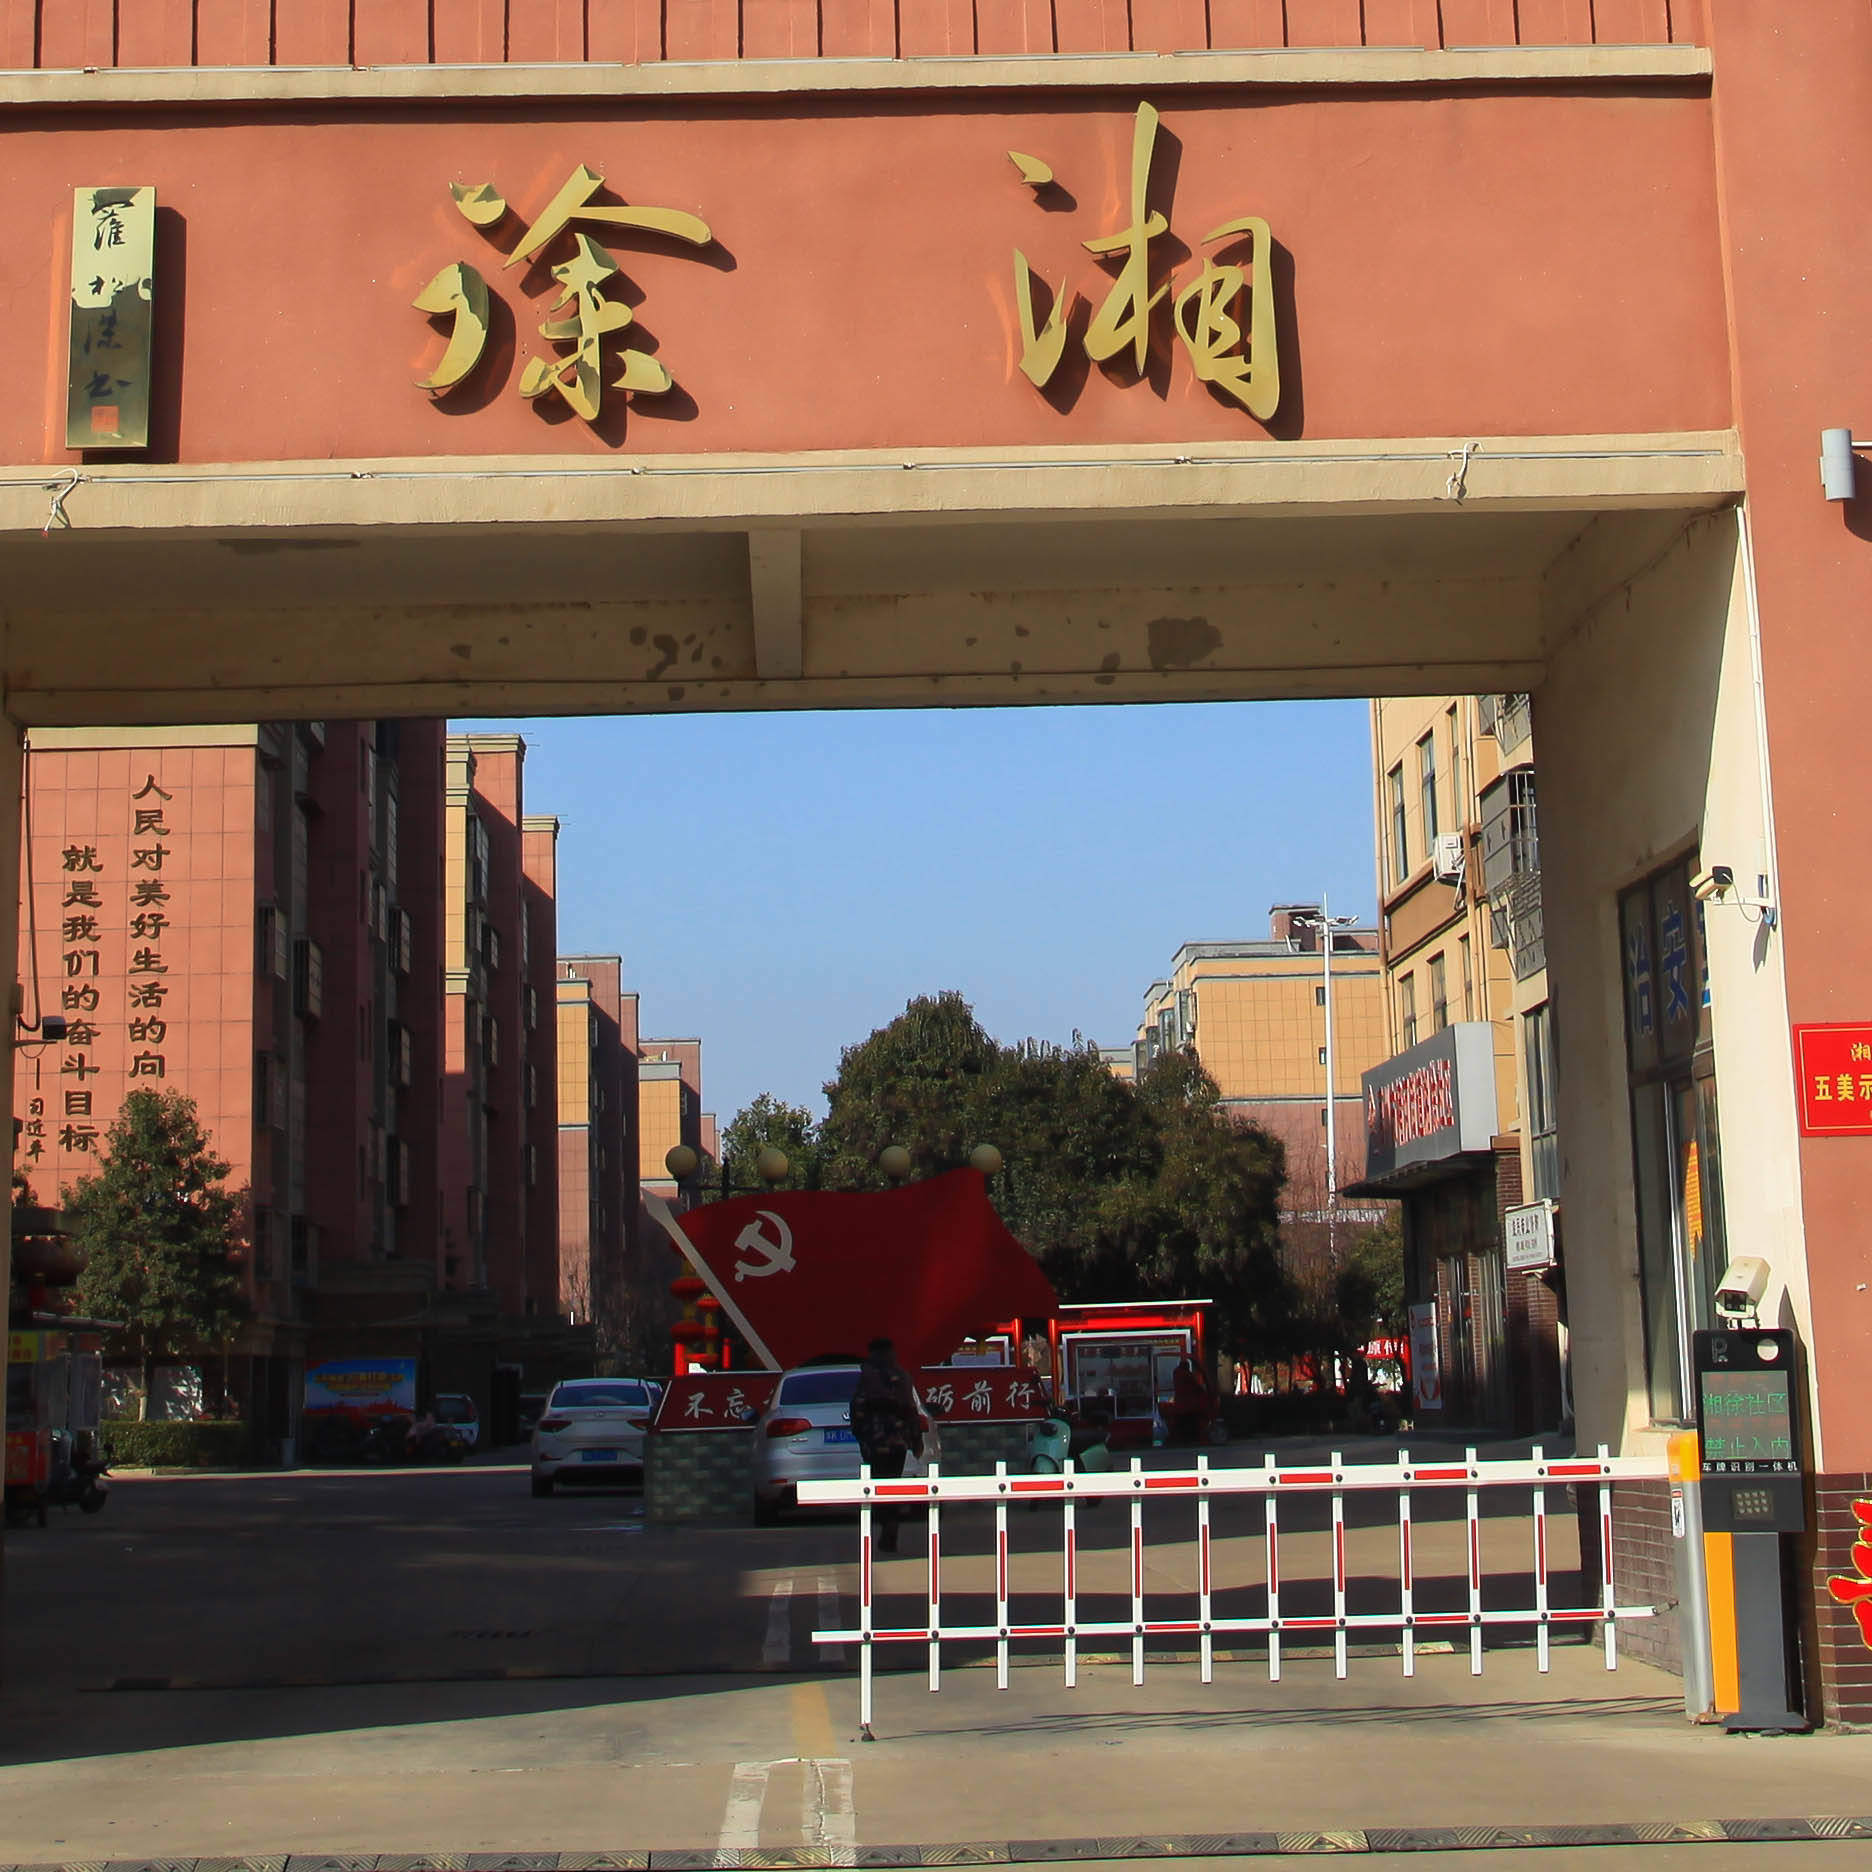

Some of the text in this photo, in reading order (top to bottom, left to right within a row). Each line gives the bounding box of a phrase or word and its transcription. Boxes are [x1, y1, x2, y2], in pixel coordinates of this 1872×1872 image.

[59, 844, 104, 1154] 就是我们的奋斗目标
[127, 774, 173, 1090] 人民对美好生活的向
